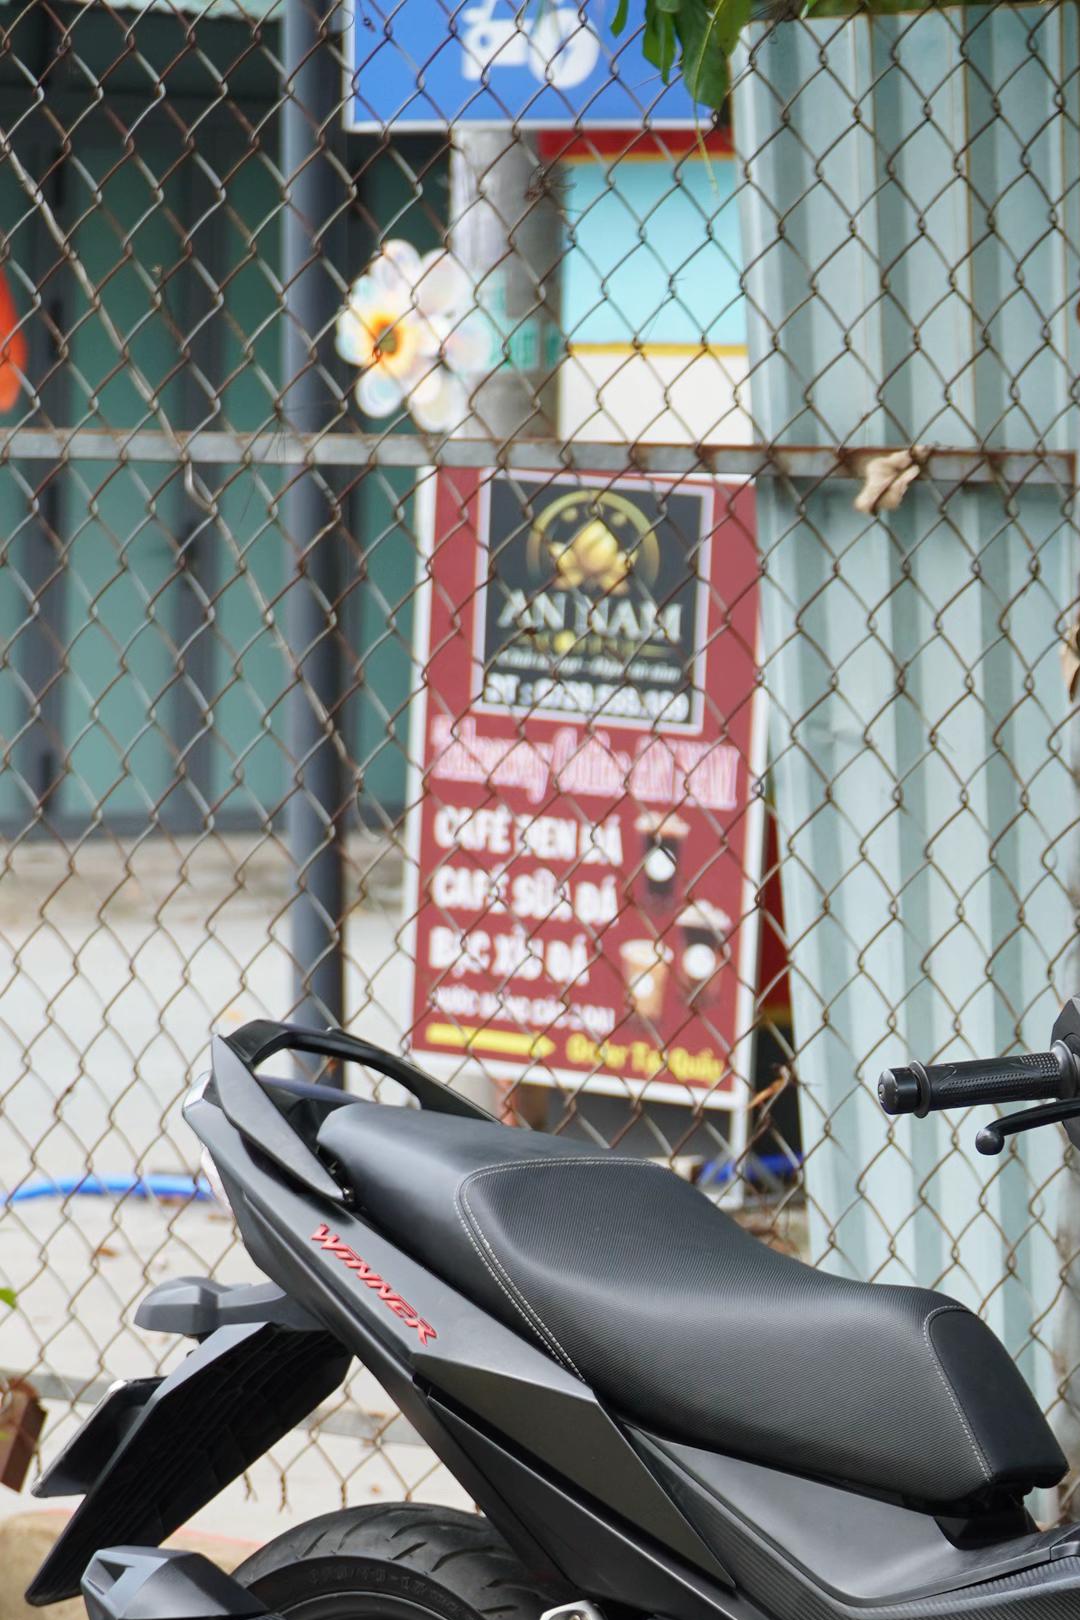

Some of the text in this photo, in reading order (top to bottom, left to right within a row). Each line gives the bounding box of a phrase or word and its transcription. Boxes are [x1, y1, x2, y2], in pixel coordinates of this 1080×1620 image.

[497, 588, 684, 643] AN NAM
[312, 1224, 437, 1345] WINNER
